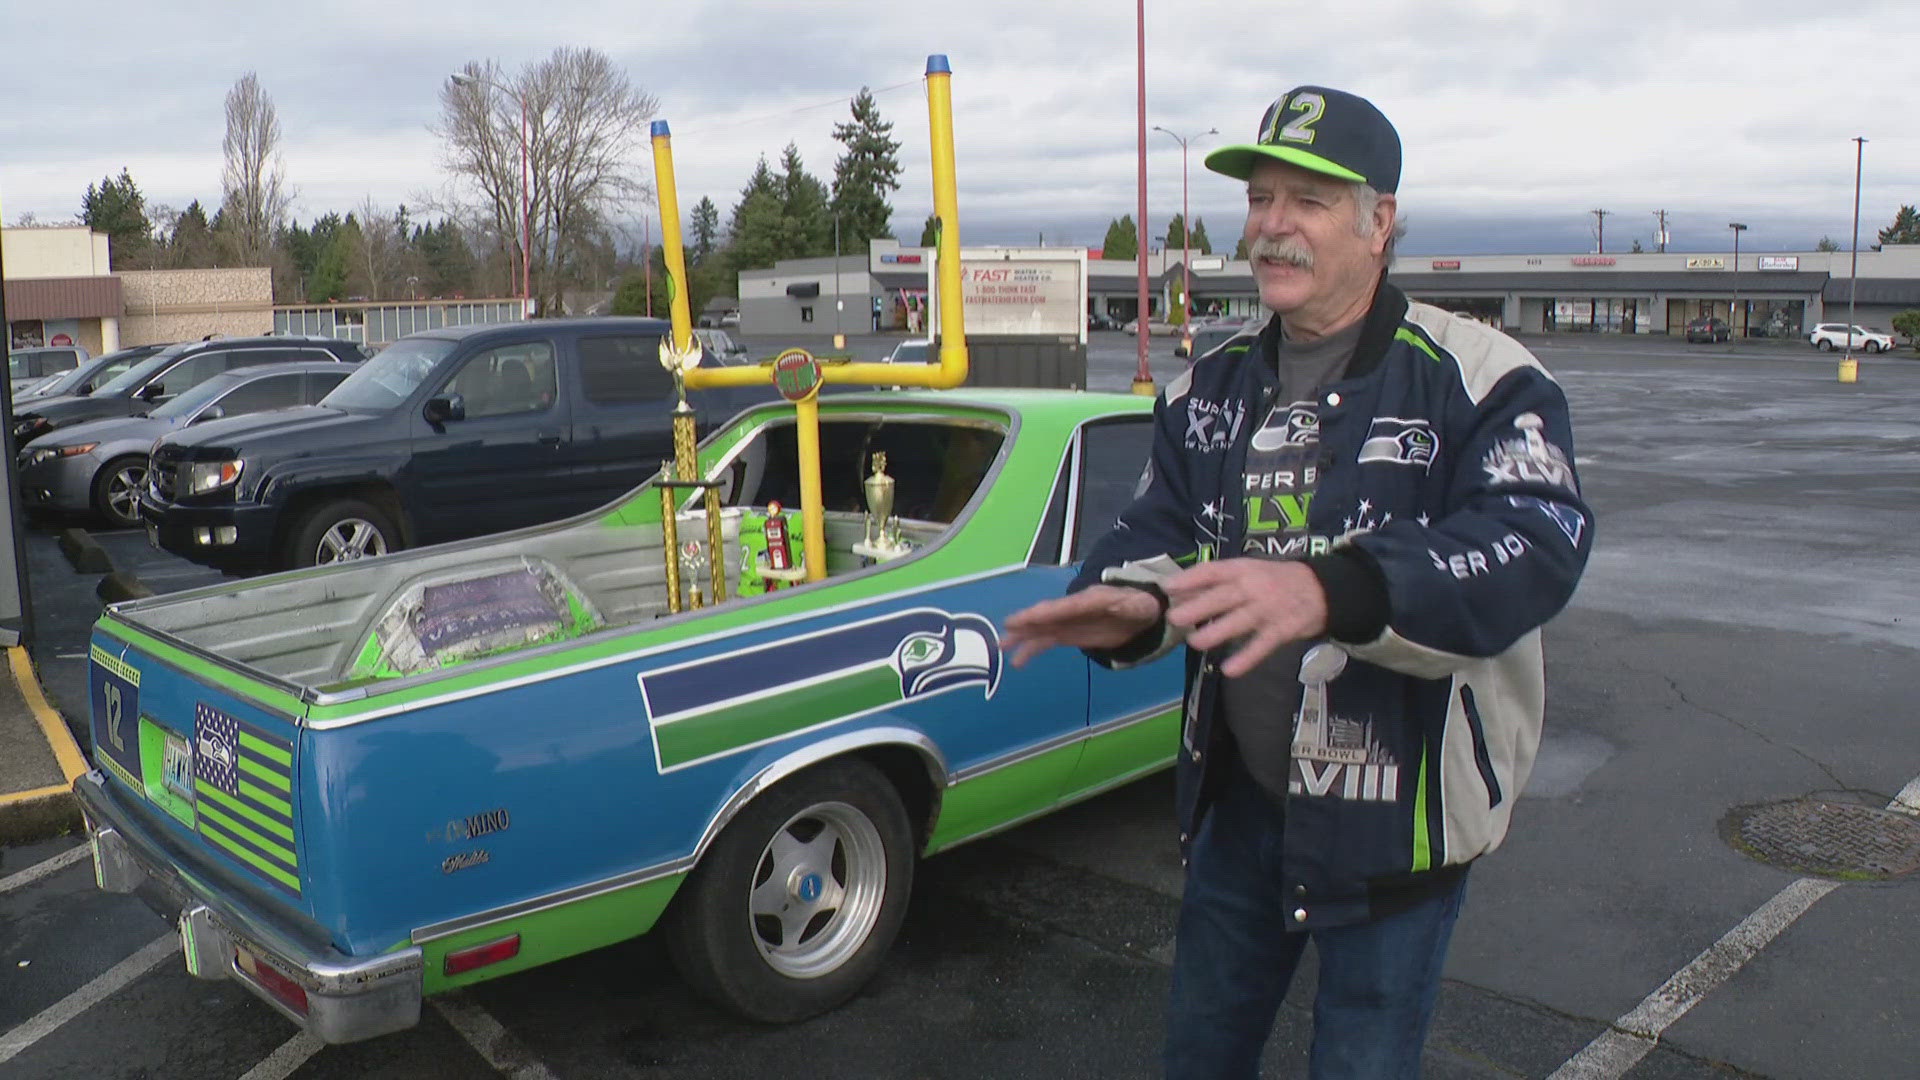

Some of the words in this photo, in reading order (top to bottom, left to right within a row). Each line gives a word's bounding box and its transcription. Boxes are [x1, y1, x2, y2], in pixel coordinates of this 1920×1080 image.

[973, 269, 1010, 282] FAST
[103, 681, 125, 753] 12
[1316, 745, 1360, 761] BOWL
